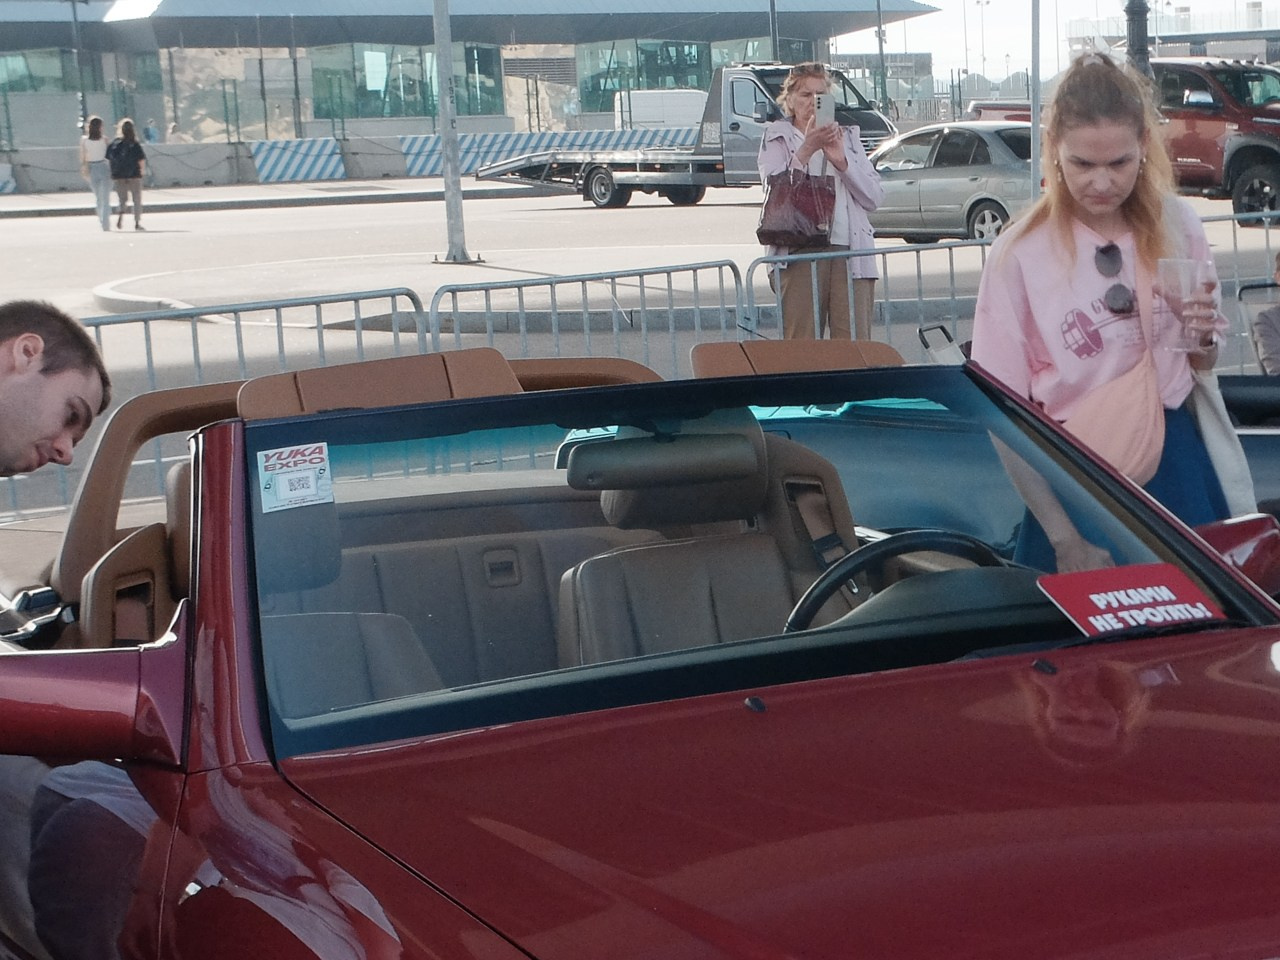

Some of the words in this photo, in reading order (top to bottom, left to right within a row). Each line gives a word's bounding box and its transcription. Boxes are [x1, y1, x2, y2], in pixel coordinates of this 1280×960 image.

[264, 445, 324, 463] YUKA
[264, 457, 325, 472] EXPO
[1089, 585, 1177, 610] РУКАМИ
[1088, 611, 1124, 632] НЕ
[1122, 602, 1212, 627] ТРОГАТЬ!
